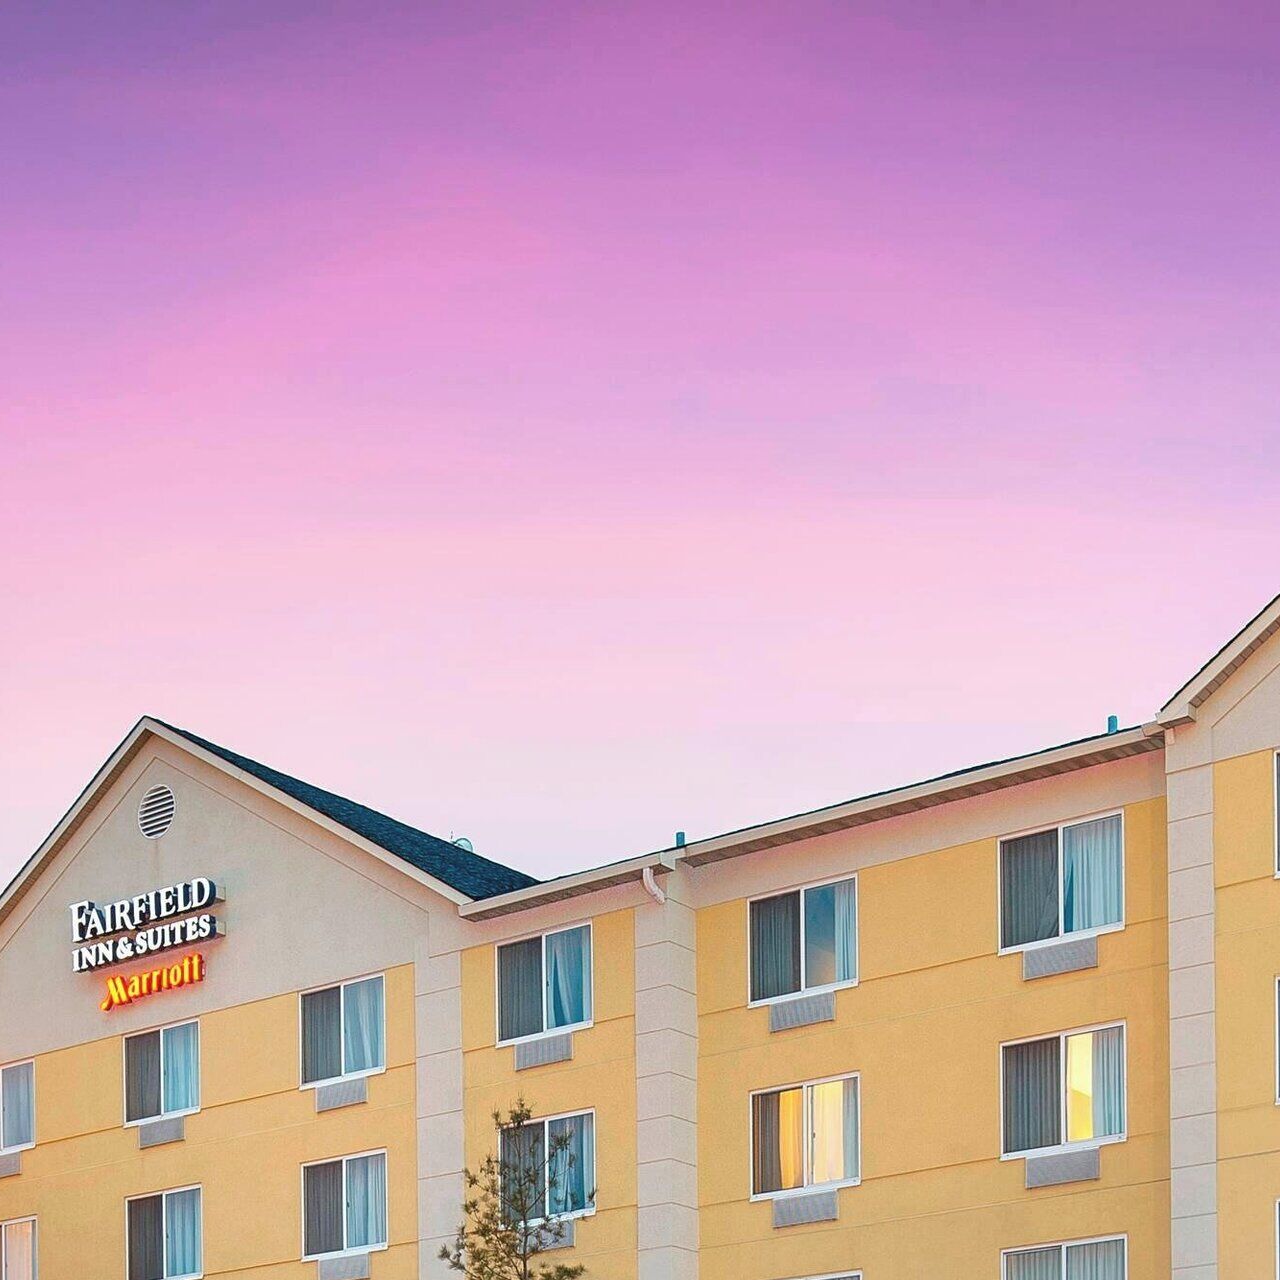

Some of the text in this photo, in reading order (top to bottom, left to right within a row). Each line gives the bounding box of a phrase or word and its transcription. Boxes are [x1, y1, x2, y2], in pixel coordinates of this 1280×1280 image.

[69, 877, 216, 943] FAIRFIELD
[72, 914, 216, 973] INN & SUITES
[99, 953, 205, 1012] Marriott
